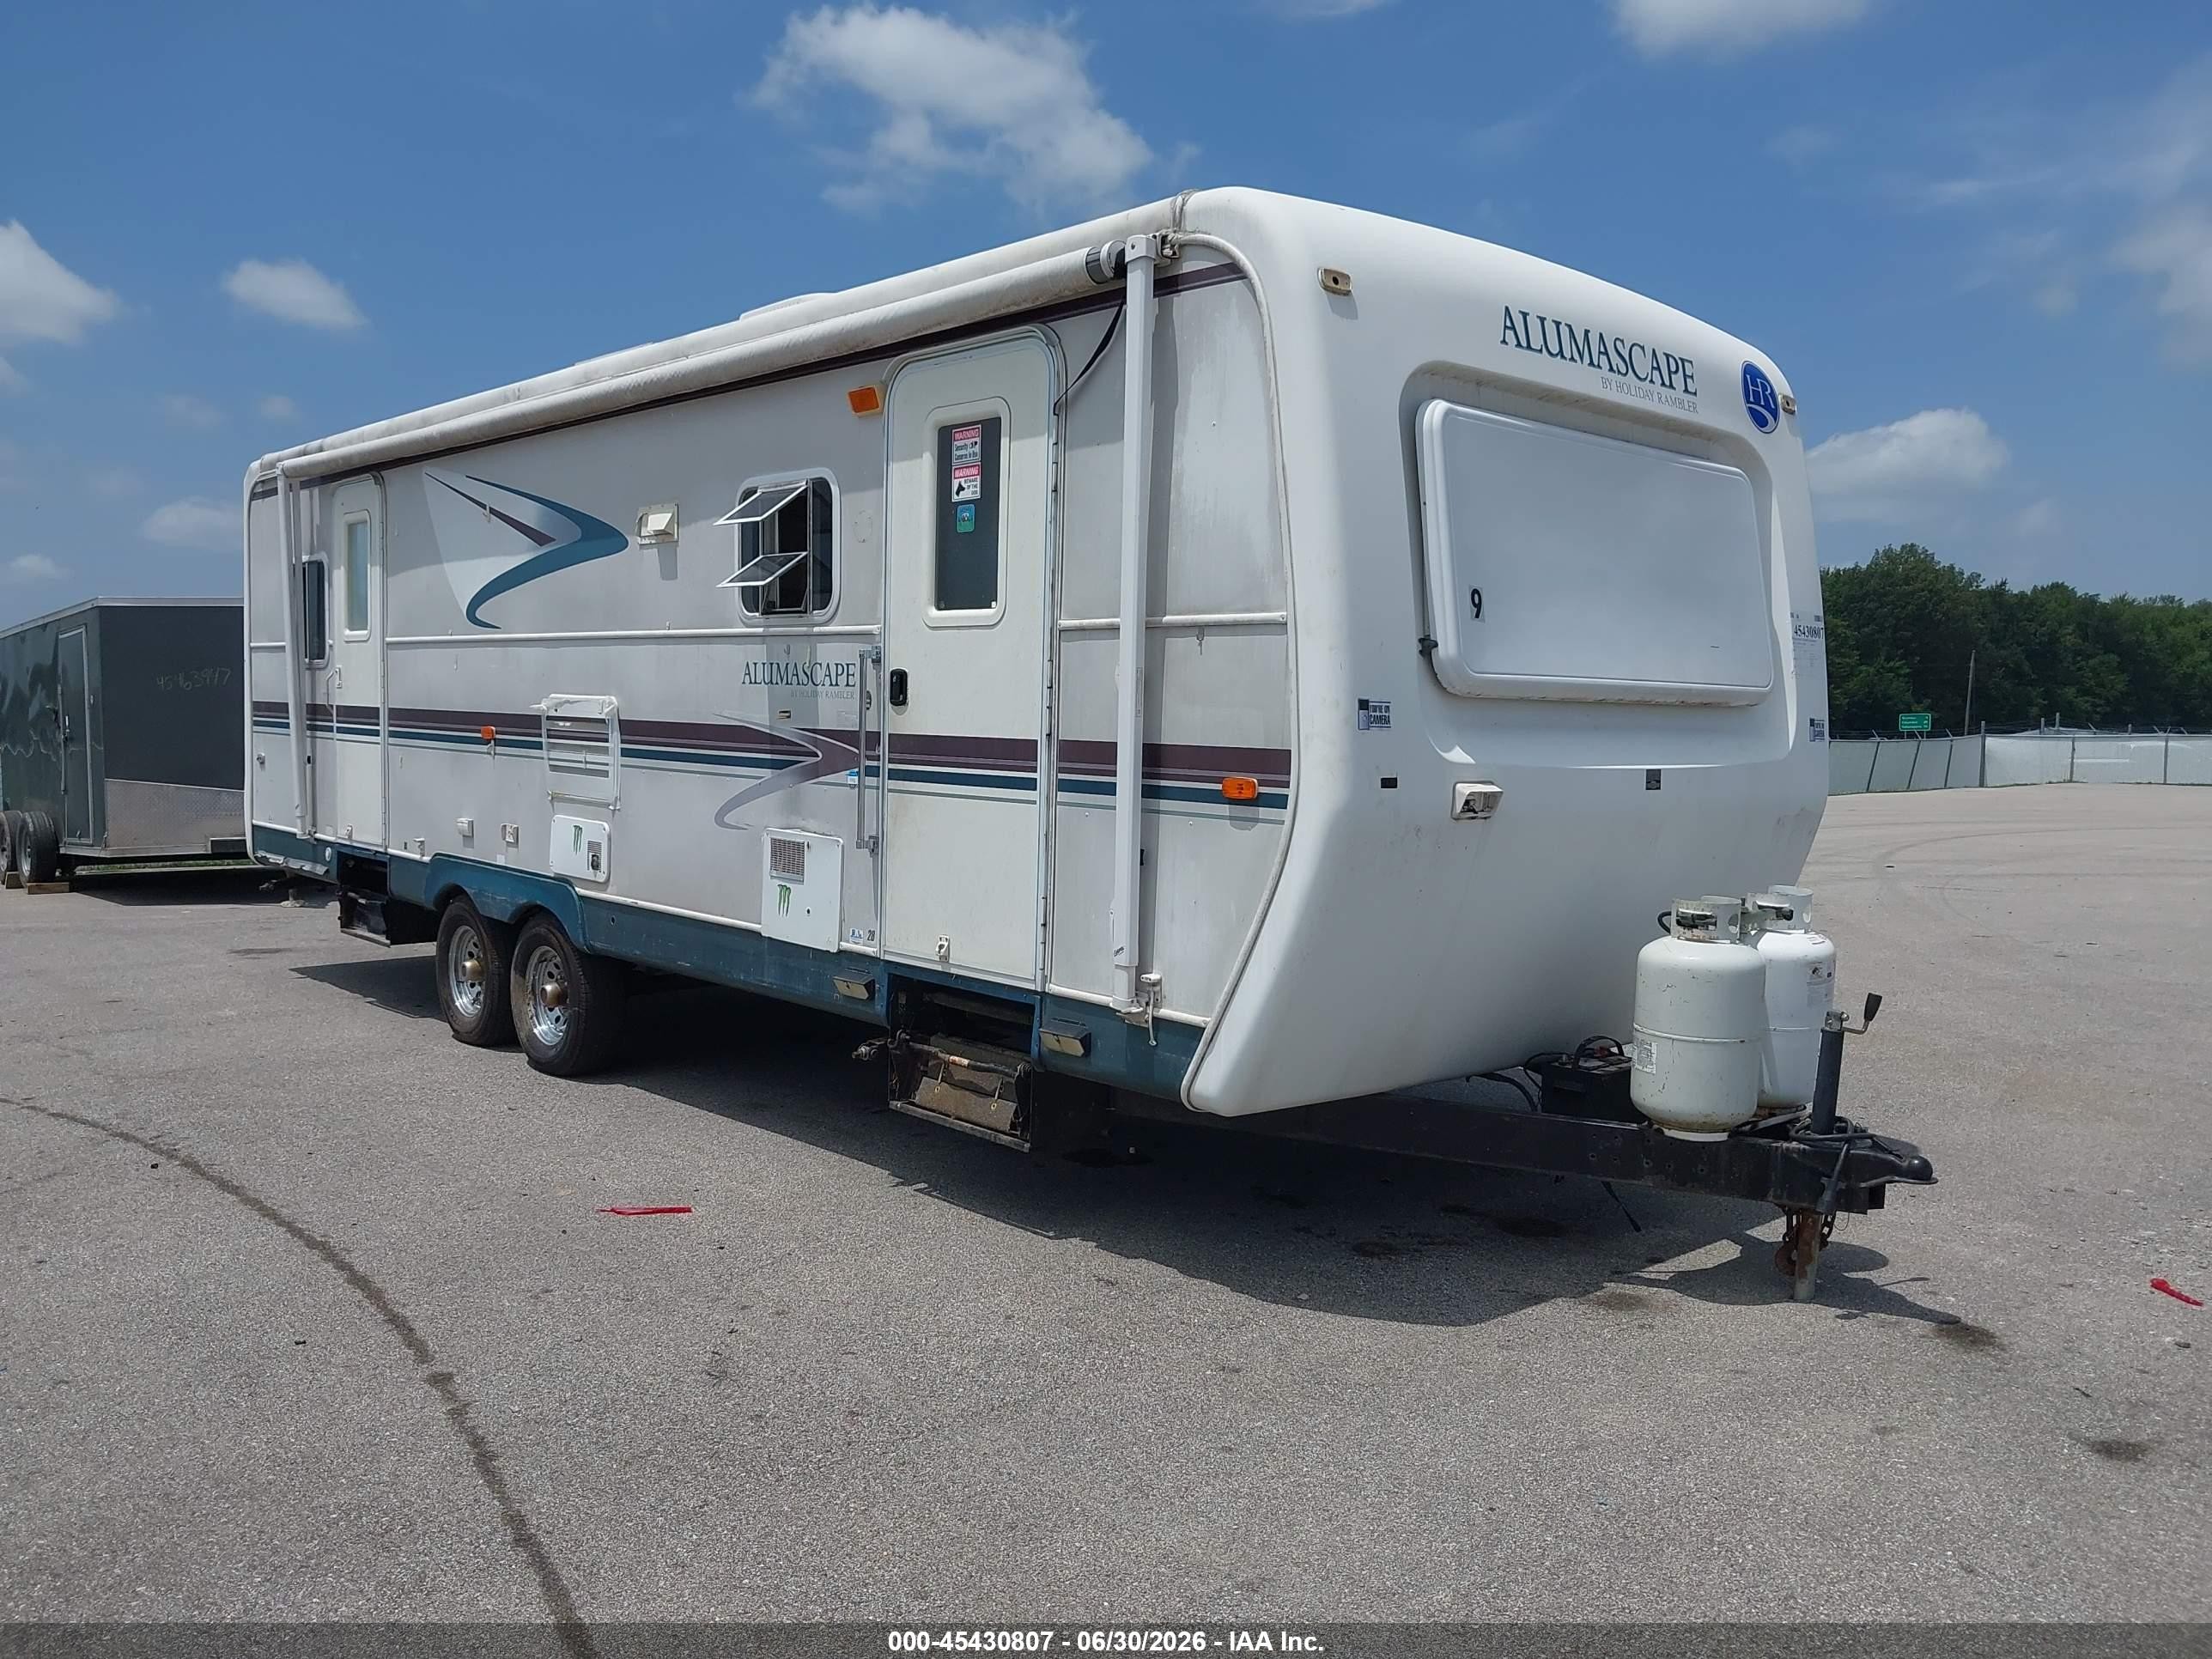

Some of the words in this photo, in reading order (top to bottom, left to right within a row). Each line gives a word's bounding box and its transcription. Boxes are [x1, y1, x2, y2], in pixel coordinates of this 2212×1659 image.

[1500, 305, 1698, 398] ALUMASCAPE
[1601, 376, 1613, 392] BY
[1615, 380, 1656, 404] HOLIDAY
[1657, 392, 1699, 414] RAMBLER
[1746, 374, 1775, 410] HR
[955, 428, 979, 441] WARNING
[955, 465, 979, 478] WARNING
[1470, 588, 1482, 619] 9
[1794, 624, 1824, 640] 45430807
[742, 661, 856, 688] ALUMASCAPE
[825, 690, 855, 700] RAMBLER
[1370, 714, 1391, 726] CAMERA
